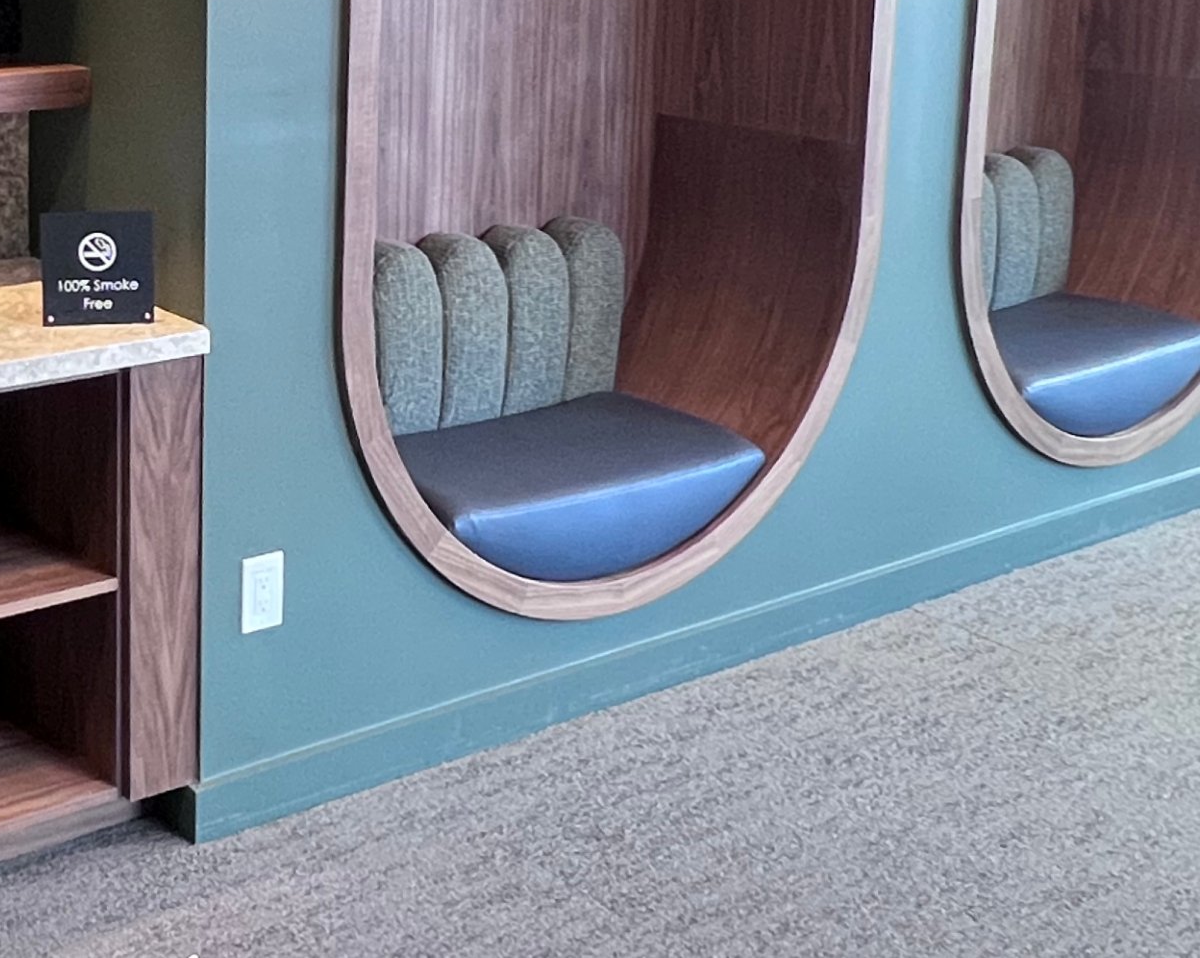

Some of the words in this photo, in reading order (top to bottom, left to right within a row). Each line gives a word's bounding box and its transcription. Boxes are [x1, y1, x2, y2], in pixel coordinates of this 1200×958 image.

[58, 279, 91, 293] 100%
[93, 278, 139, 292] Smoke
[83, 297, 113, 310] Free
